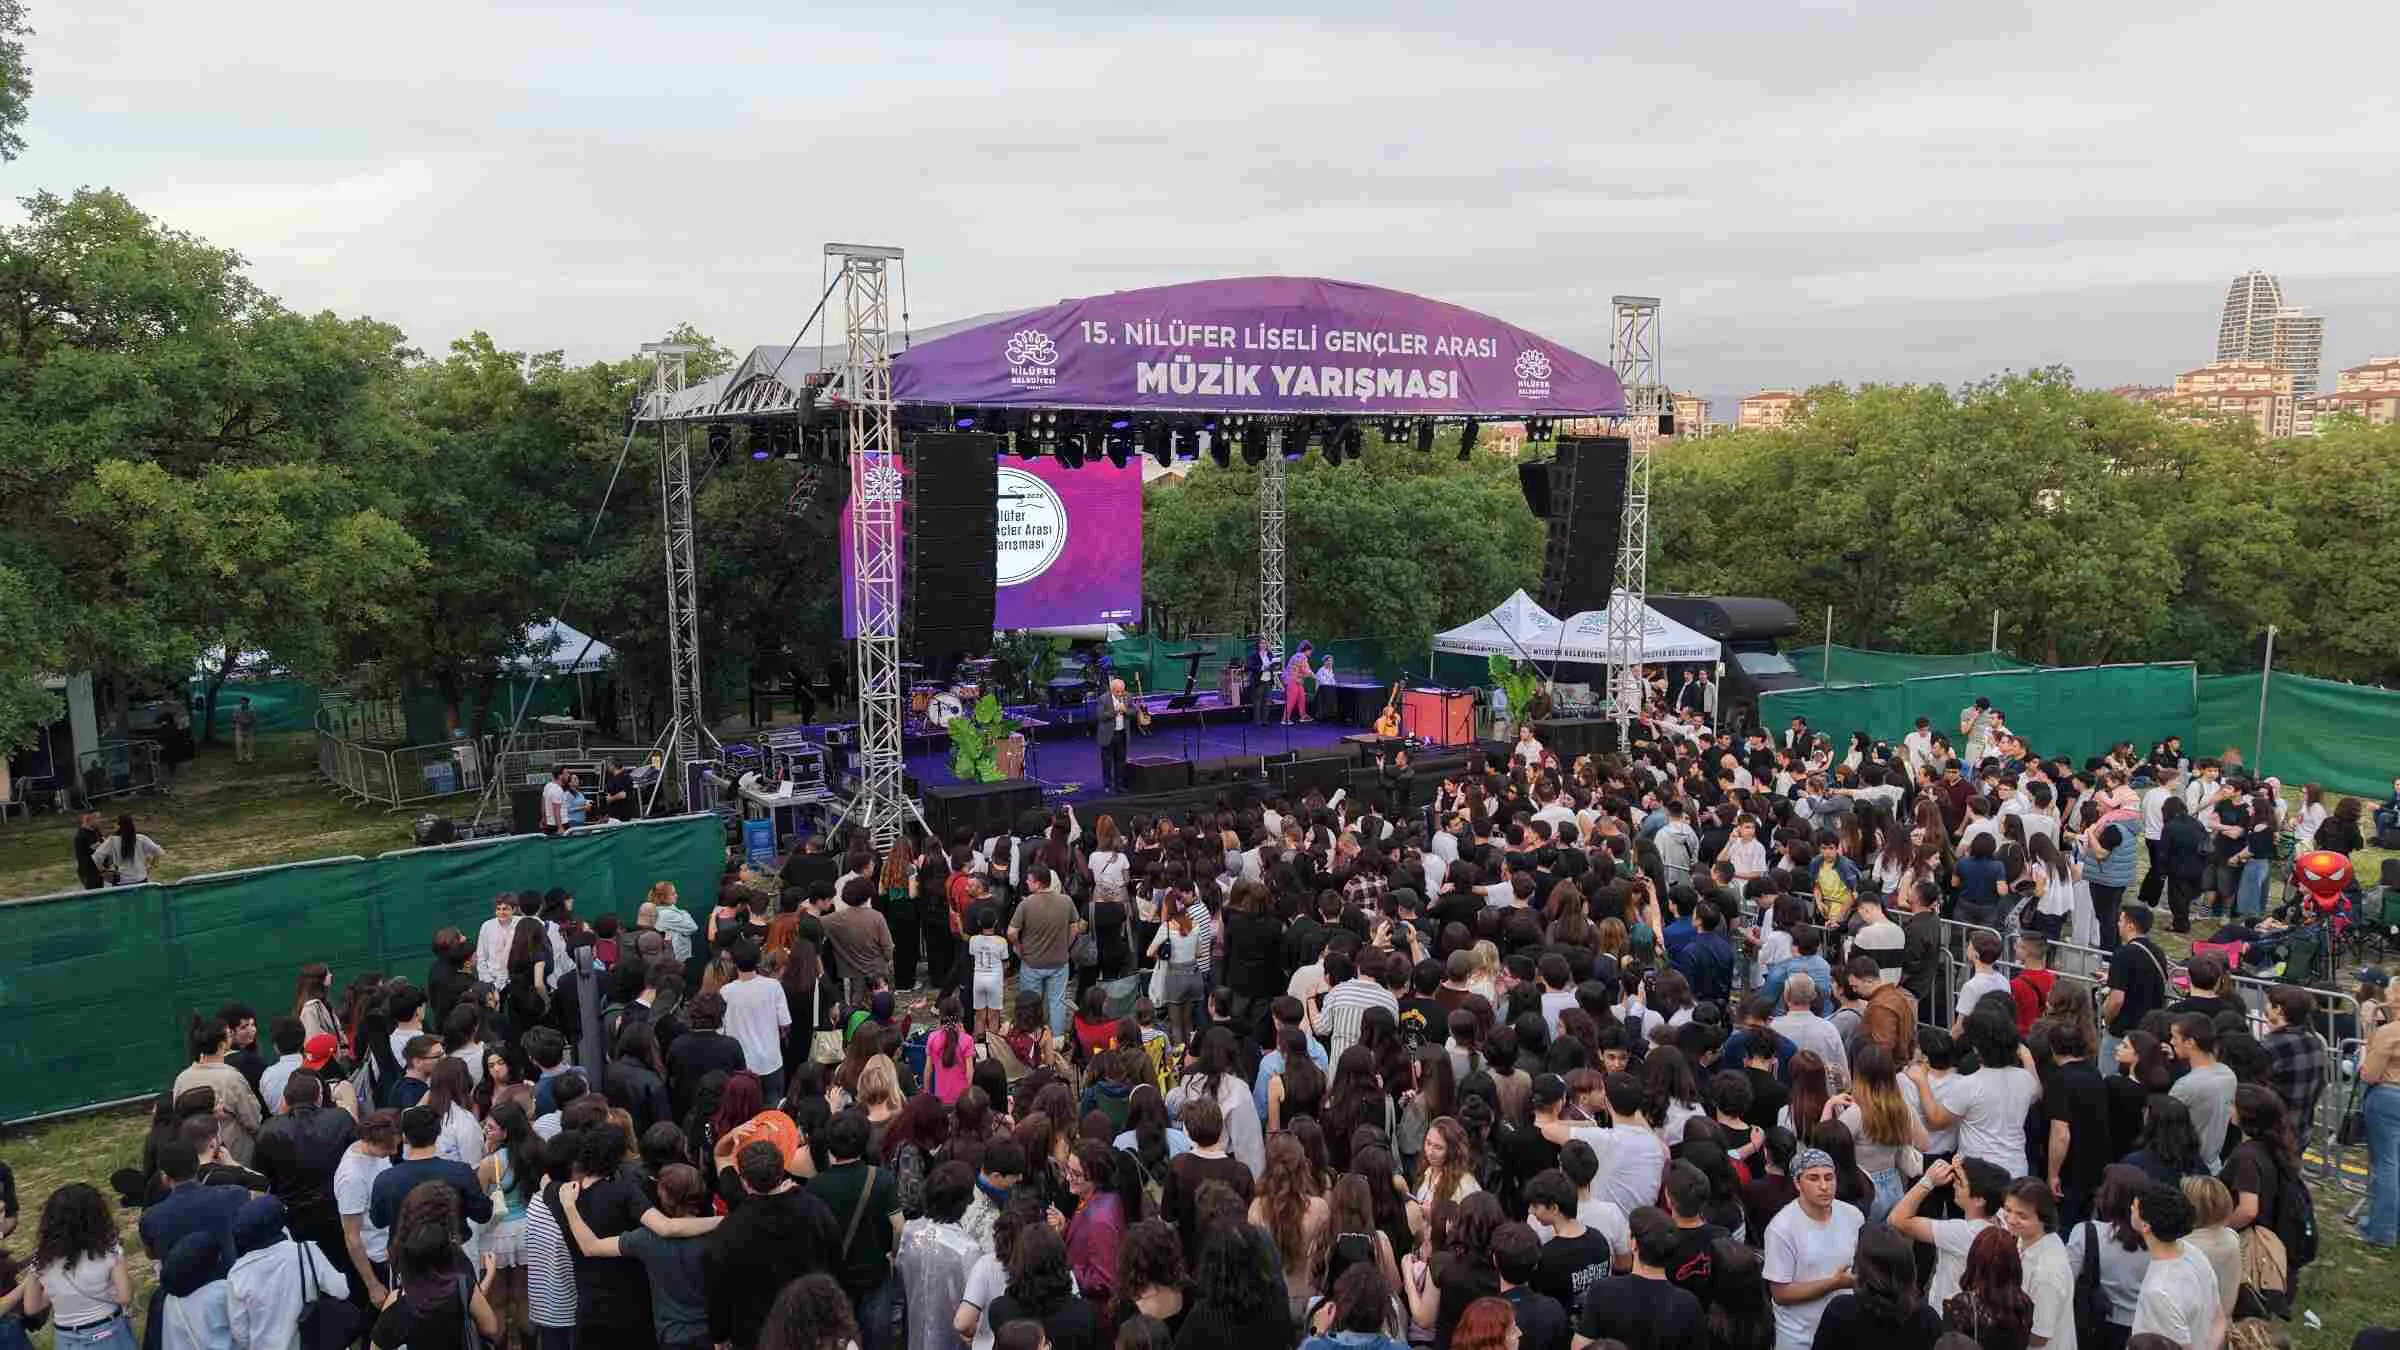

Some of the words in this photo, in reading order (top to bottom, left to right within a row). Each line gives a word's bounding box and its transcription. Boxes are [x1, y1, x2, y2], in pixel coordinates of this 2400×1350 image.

[1081, 321, 1116, 345] 15.
[1124, 318, 1236, 349] NİLÜFER
[1244, 323, 1317, 351] LİSELİ
[1324, 329, 1428, 357] GENÇLER
[1434, 335, 1497, 358] ARASI
[1136, 354, 1262, 396] MÜZİK
[1271, 365, 1459, 403] YARIŞMASI
[1025, 524, 1052, 537] Arası
[998, 539, 1044, 551] arışması
